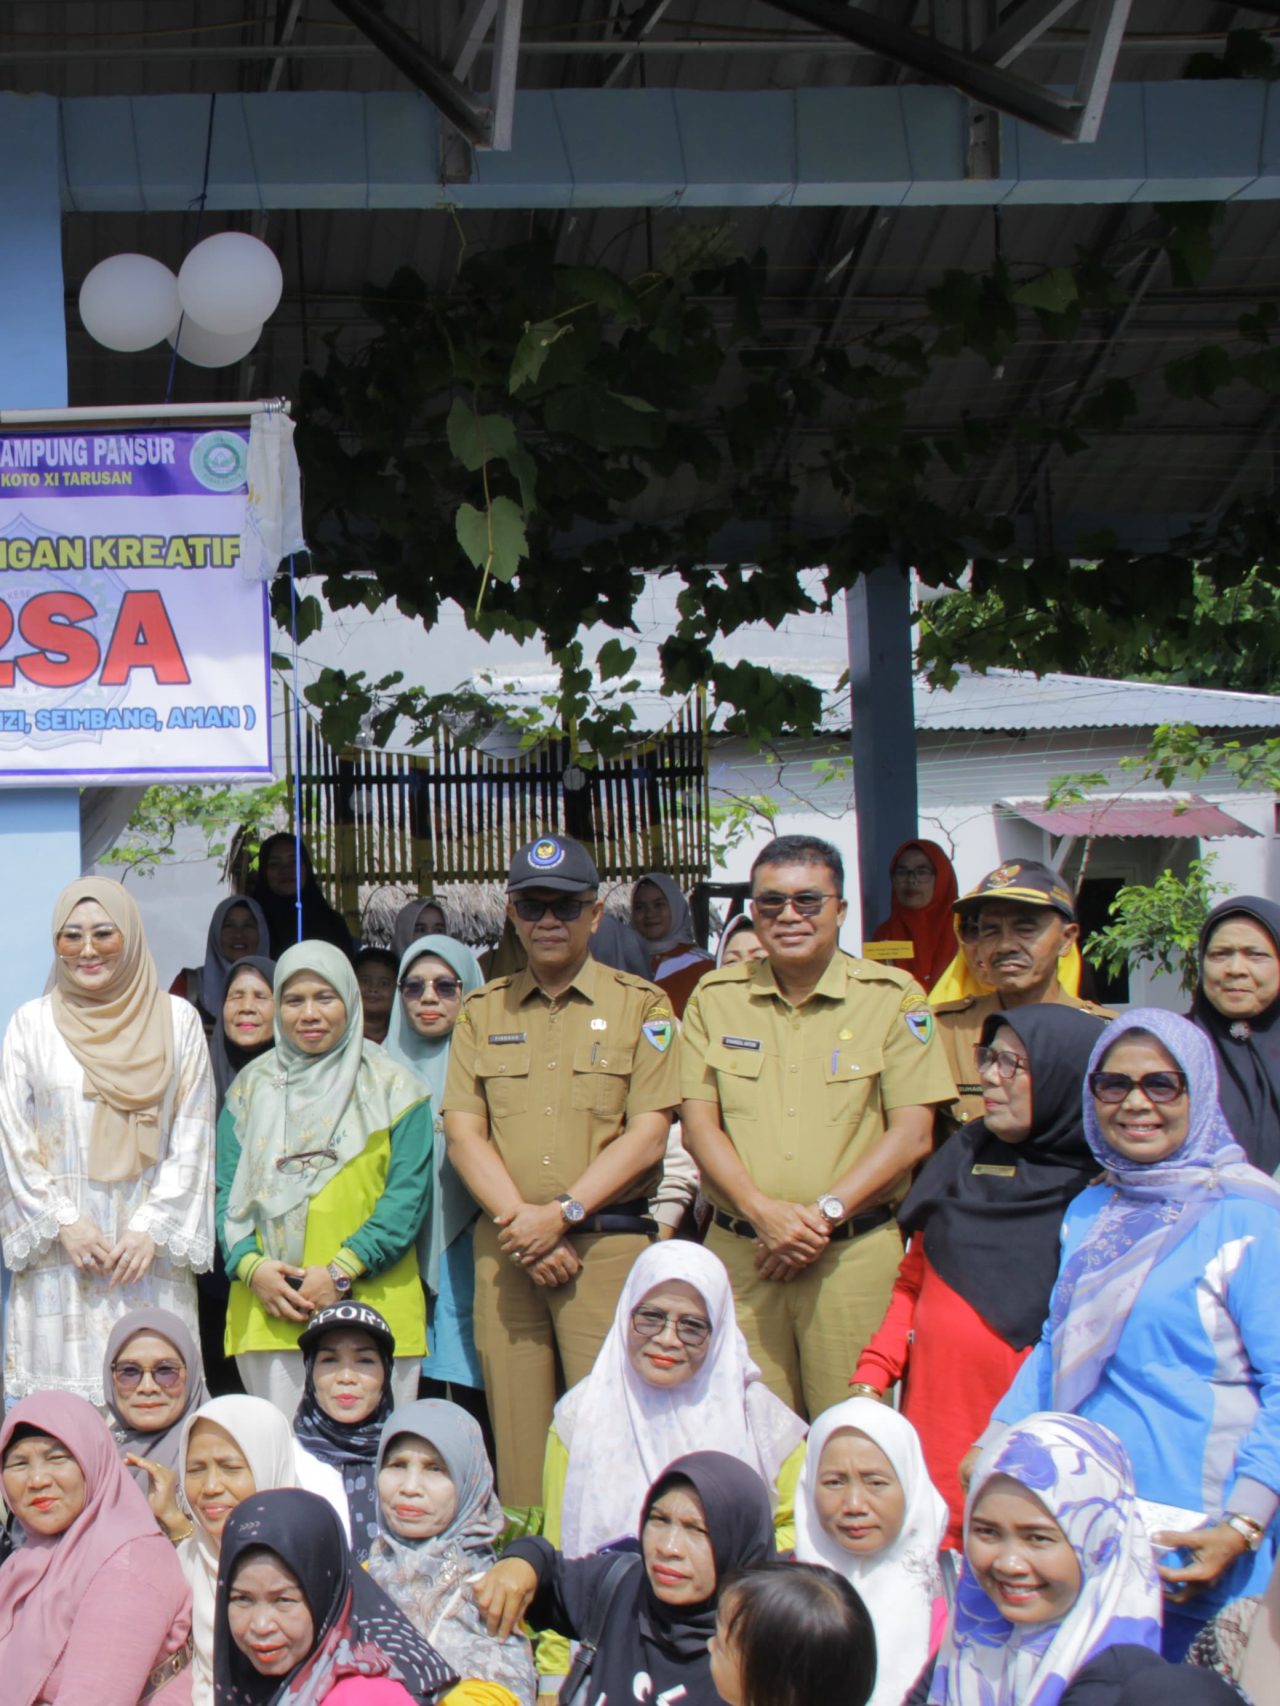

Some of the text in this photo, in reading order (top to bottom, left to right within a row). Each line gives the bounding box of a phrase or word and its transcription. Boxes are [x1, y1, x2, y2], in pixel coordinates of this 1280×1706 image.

[93, 436, 176, 466] PANSUR
[1, 472, 40, 487] KOTO
[44, 472, 59, 486] XI
[62, 471, 132, 486] TARUSAN
[89, 534, 241, 570] KREATIF
[35, 706, 163, 733] SEIMBANG,
[166, 705, 241, 730] AMAN
[243, 704, 257, 731] )
